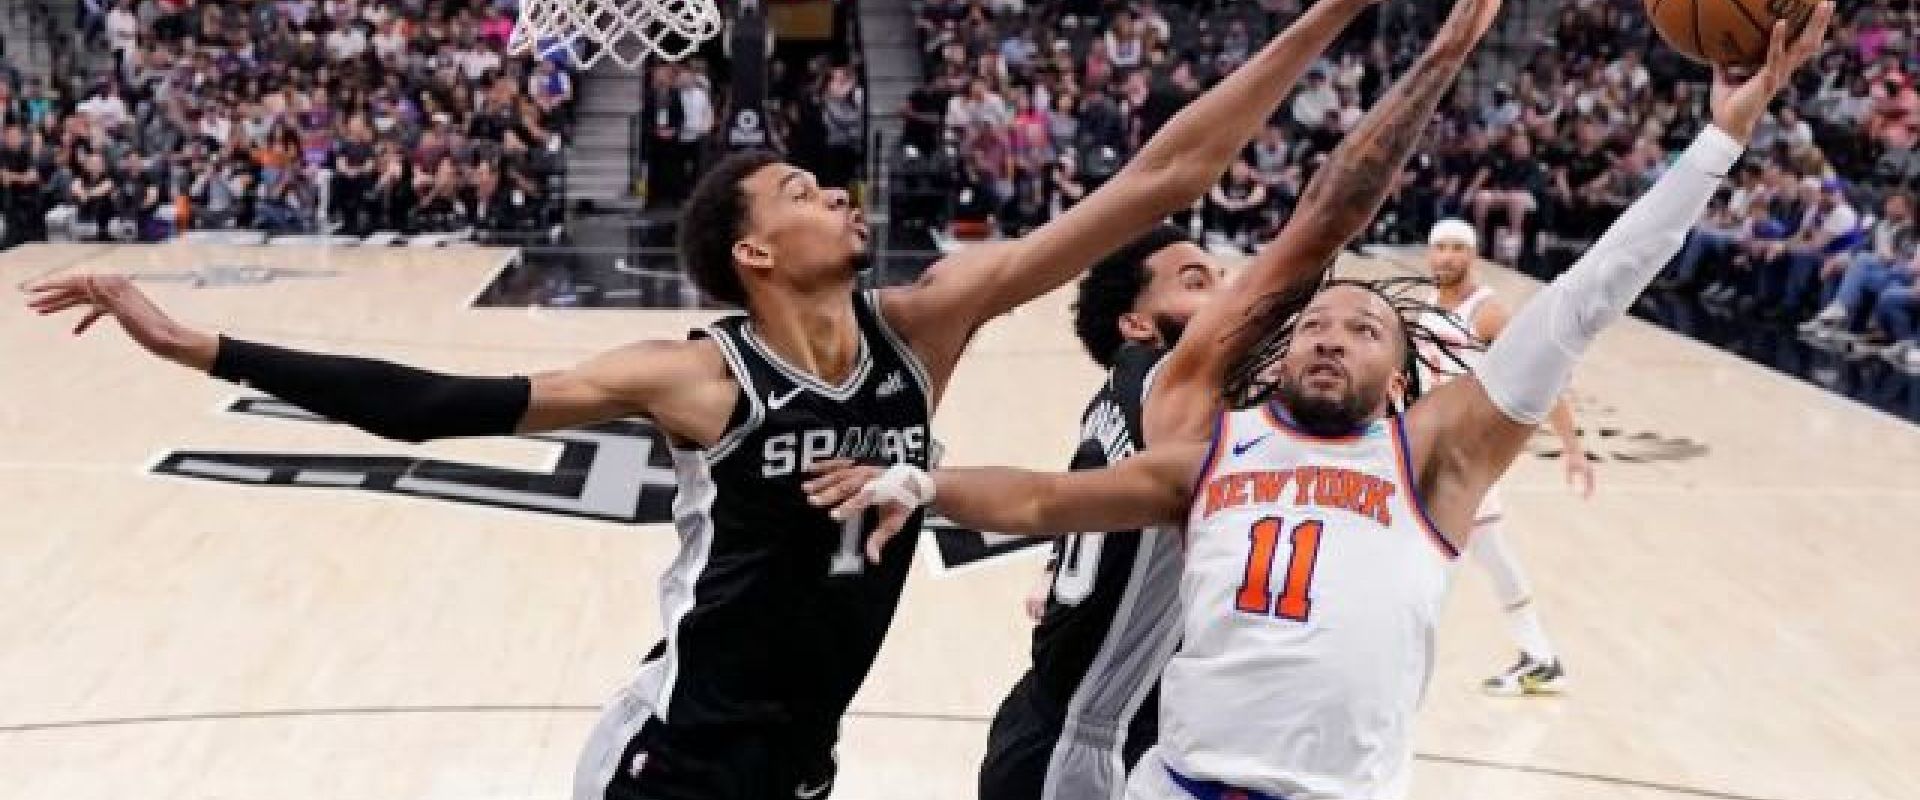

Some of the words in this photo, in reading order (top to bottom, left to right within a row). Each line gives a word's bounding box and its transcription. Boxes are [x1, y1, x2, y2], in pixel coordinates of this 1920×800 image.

[1202, 470, 1294, 519] NEW
[1293, 466, 1396, 528] YORK
[1235, 516, 1324, 623] 11
